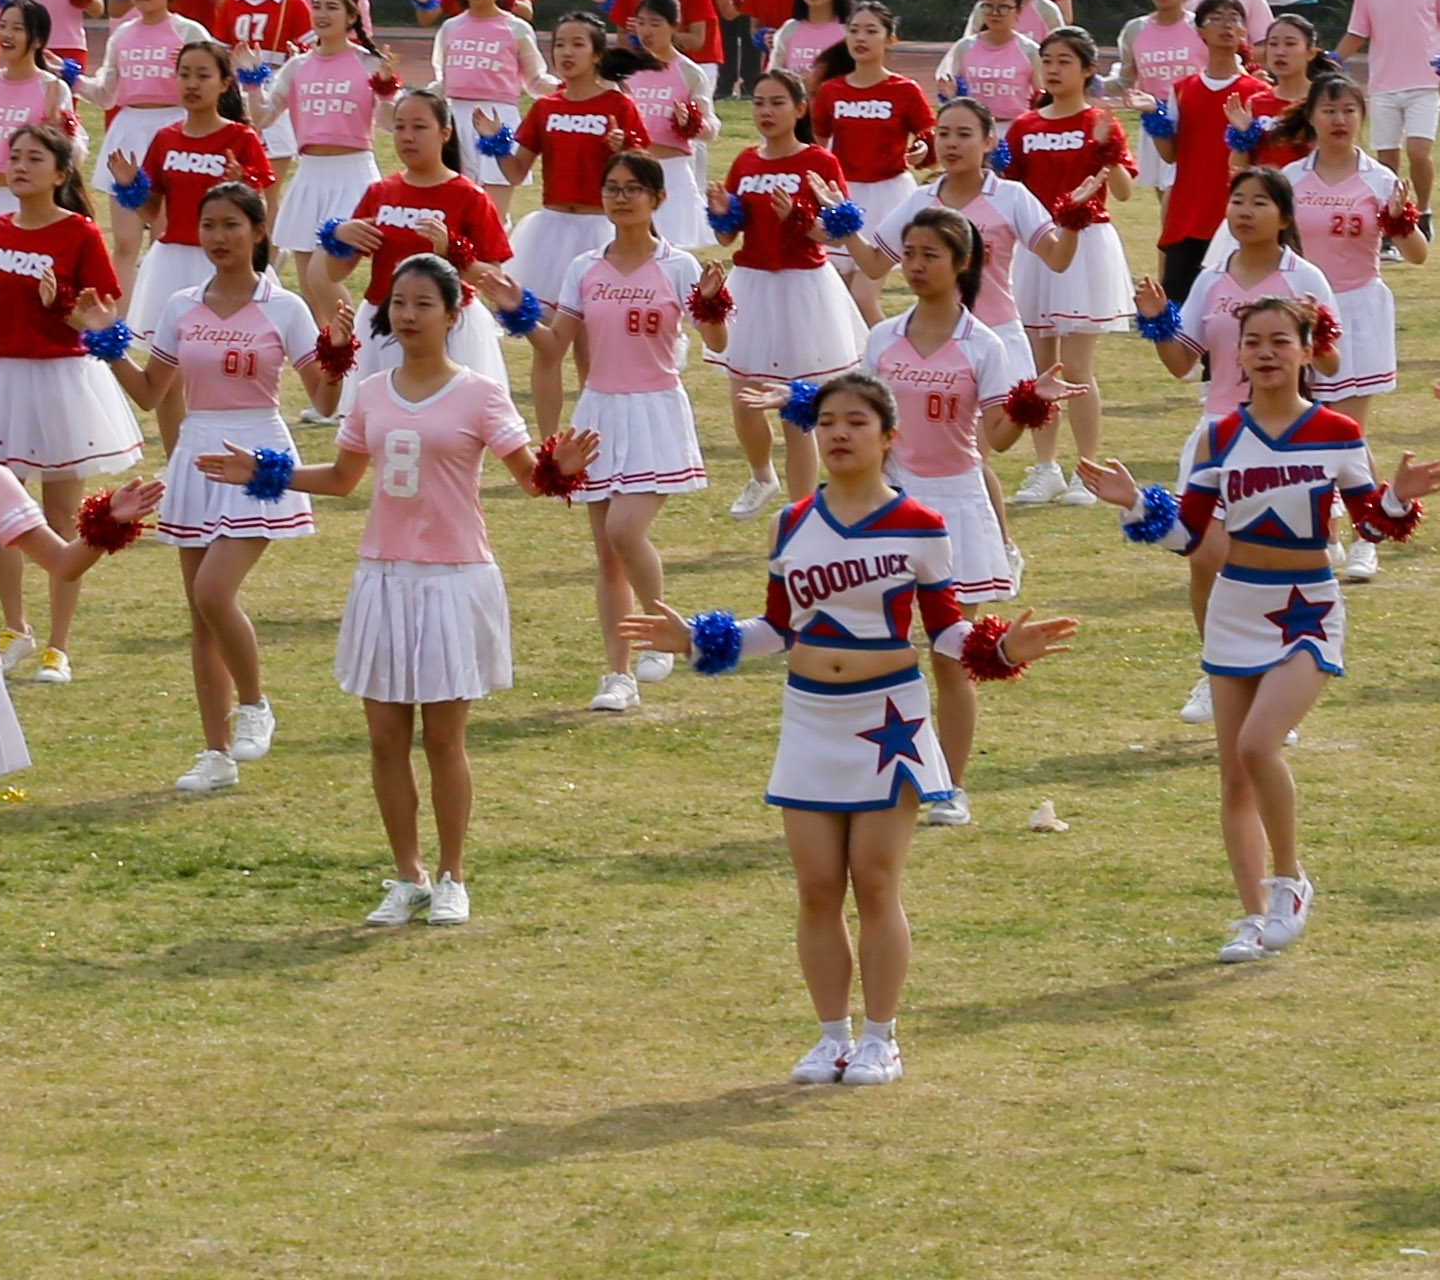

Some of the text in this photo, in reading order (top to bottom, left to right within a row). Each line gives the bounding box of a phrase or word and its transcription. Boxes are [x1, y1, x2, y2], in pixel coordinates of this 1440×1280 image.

[235, 15, 269, 41] 07
[119, 45, 167, 61] acid
[450, 37, 501, 54] acid
[1140, 46, 1189, 62] acid
[118, 65, 175, 80] ugar
[299, 78, 351, 95] acid
[635, 85, 673, 101] cid
[967, 82, 1020, 97] ugar
[299, 98, 357, 115] ugar
[834, 98, 891, 121] PARIS
[547, 112, 608, 136] PARIS
[1023, 130, 1084, 153] PARIS
[163, 150, 227, 176] PARIS
[737, 172, 800, 195] PARIS
[1298, 191, 1356, 210] Happy
[1332, 214, 1362, 238] 23
[593, 282, 657, 304] Happy
[626, 308, 661, 336] 89
[186, 324, 257, 346] Happy
[224, 349, 258, 378] 01
[887, 362, 957, 388] Happy
[926, 395, 959, 423] 01
[382, 429, 420, 497] 8
[788, 554, 909, 609] GOODLUCK
